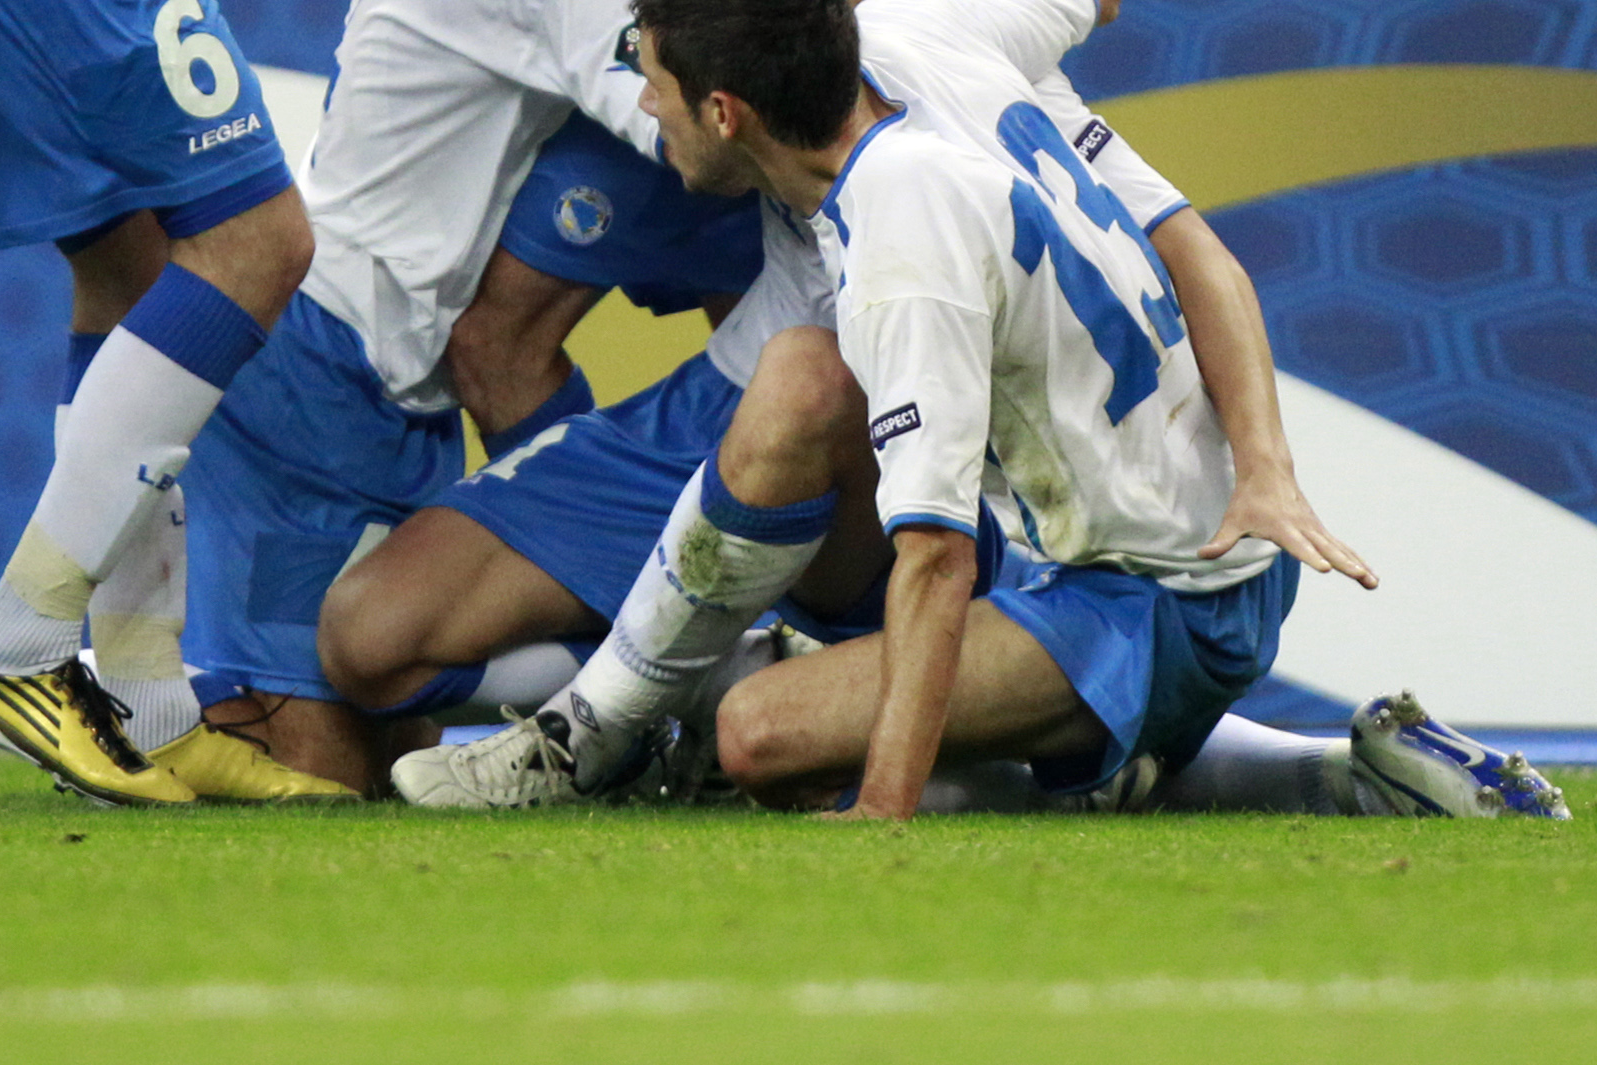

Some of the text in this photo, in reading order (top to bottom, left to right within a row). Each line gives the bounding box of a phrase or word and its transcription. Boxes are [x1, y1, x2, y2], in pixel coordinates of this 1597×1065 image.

[188, 112, 263, 155] LEGEA
[1077, 124, 1107, 157] PECT
[873, 408, 918, 438] RESPECT
